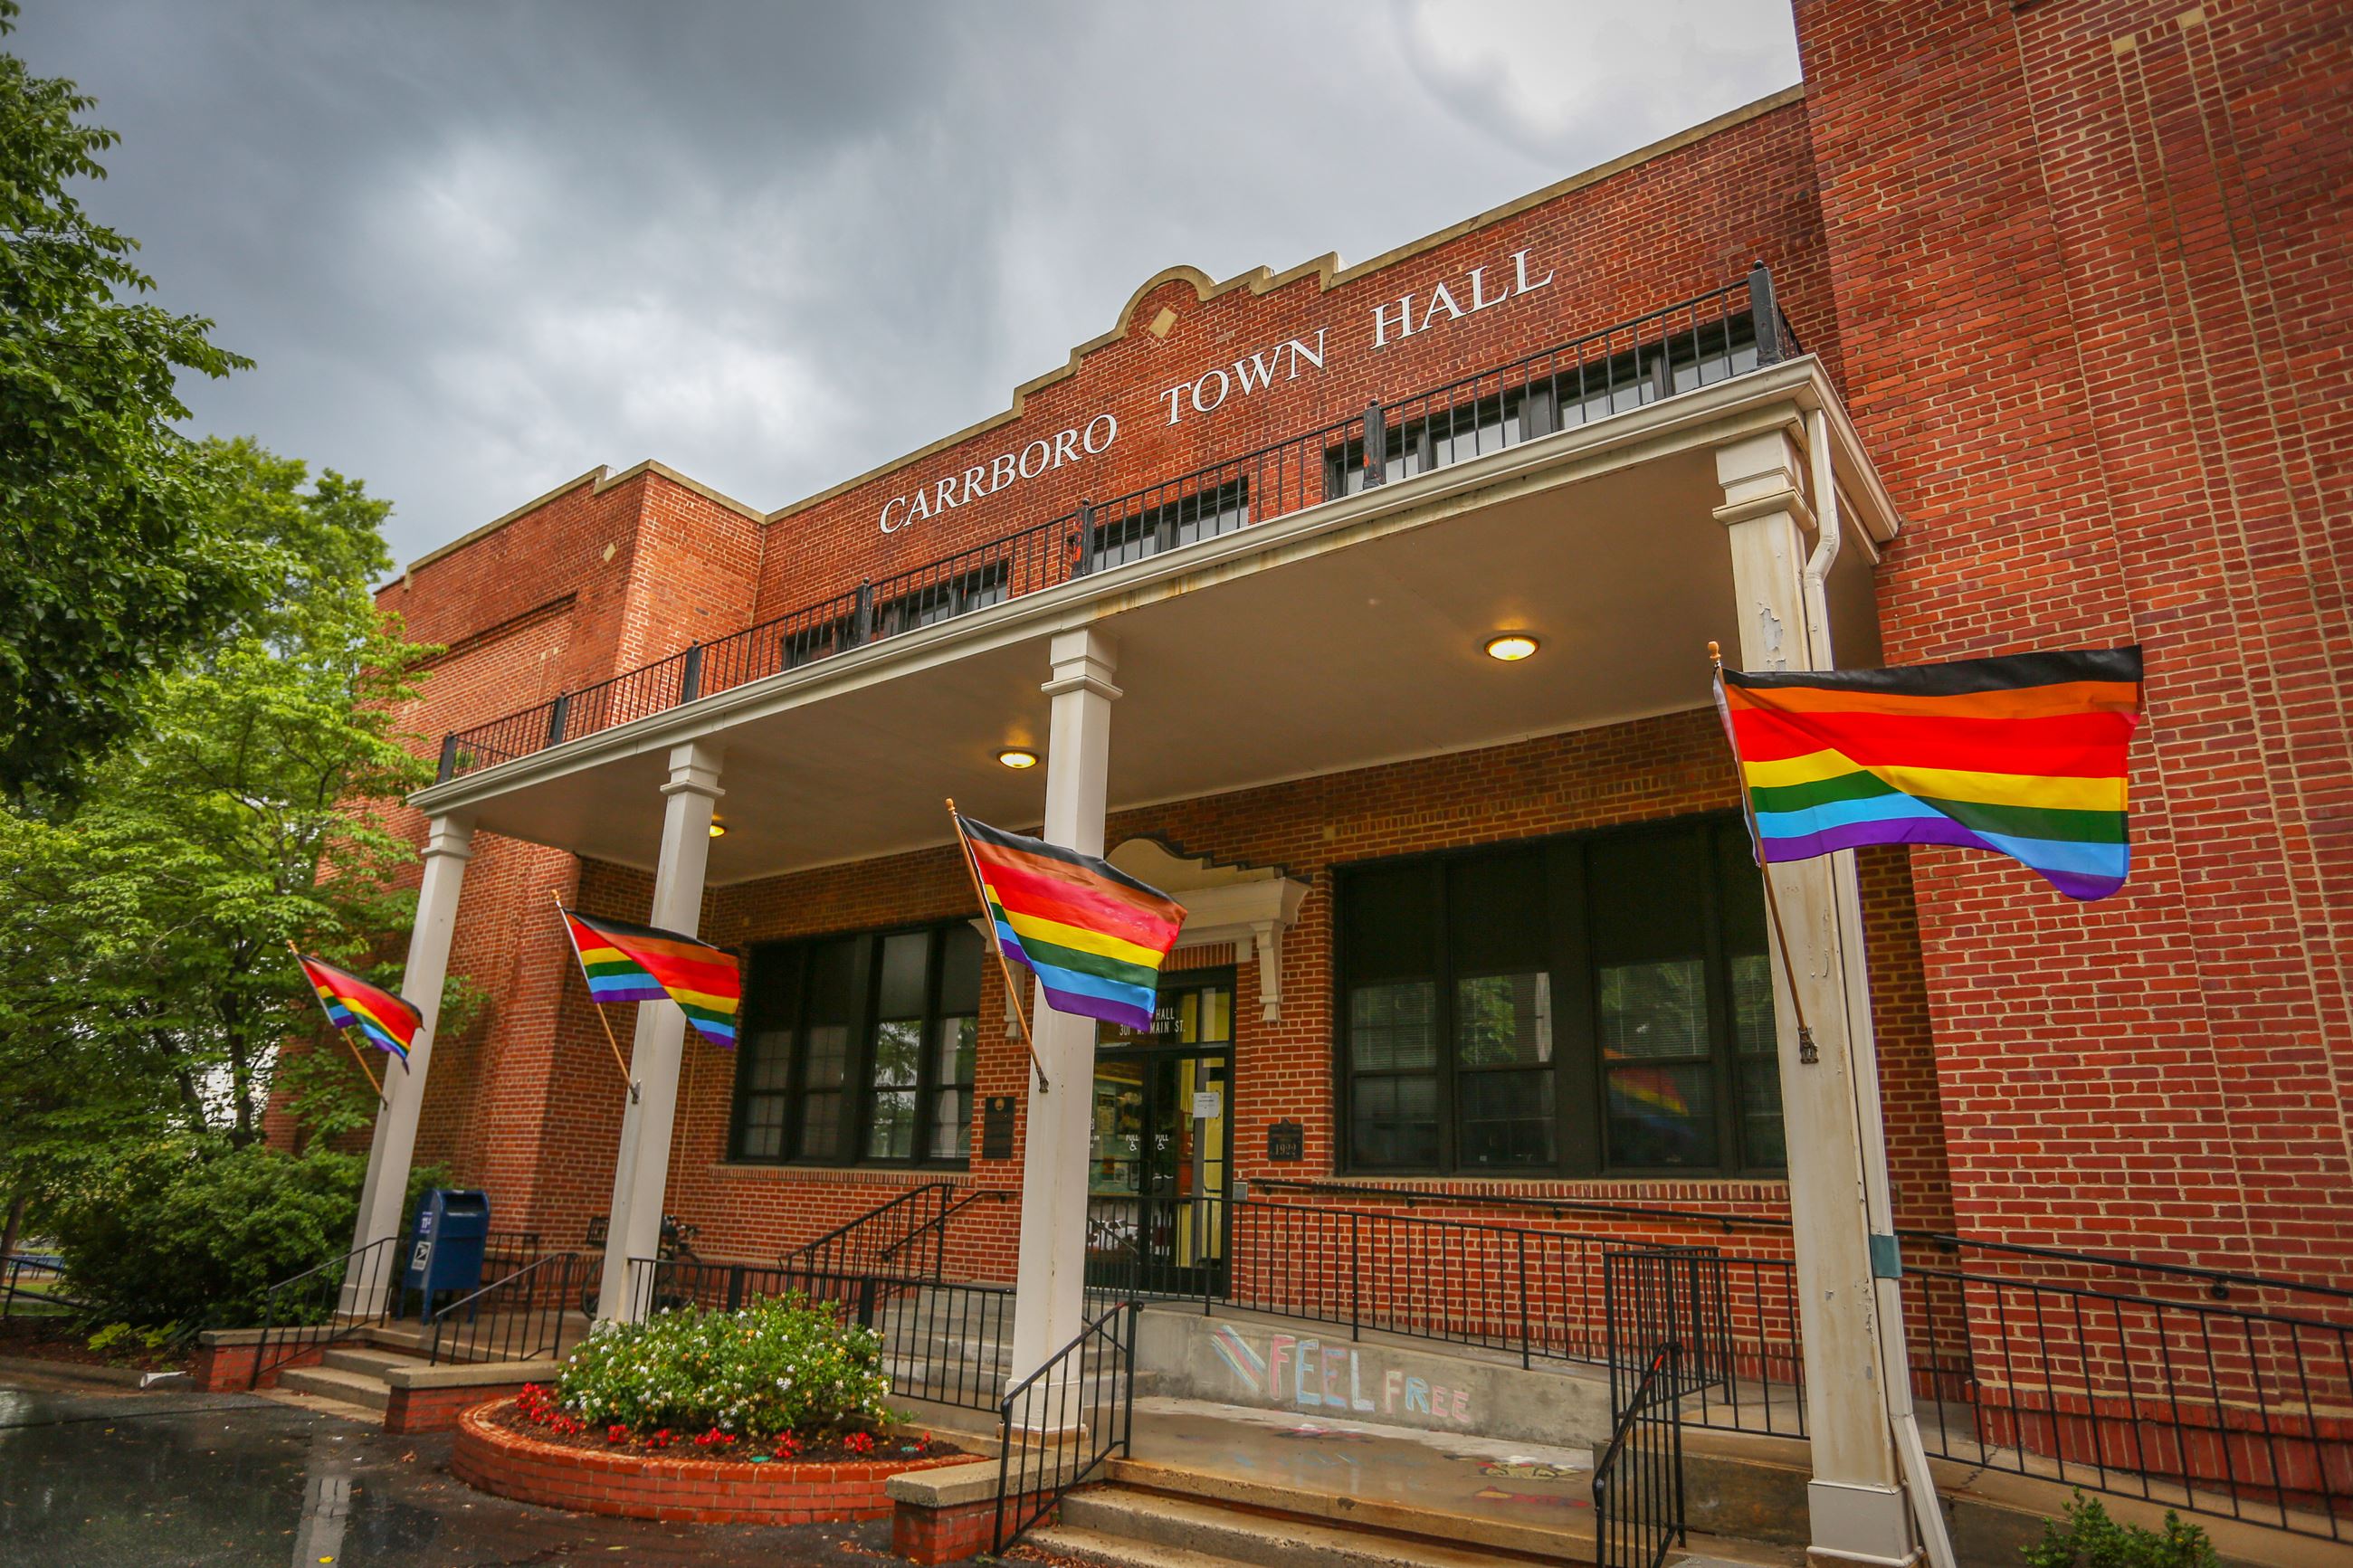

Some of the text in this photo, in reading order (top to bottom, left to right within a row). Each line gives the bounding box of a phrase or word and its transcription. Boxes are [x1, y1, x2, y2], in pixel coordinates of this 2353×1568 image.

[879, 248, 1555, 534] CARRBORO TOWN HALL
[1156, 1007, 1175, 1021] HALL
[1150, 1021, 1169, 1034] MAIN
[1175, 1020, 1186, 1033] ST.
[1156, 1134, 1169, 1142] PULL
[1270, 1335, 1471, 1422] FEEL FREE
